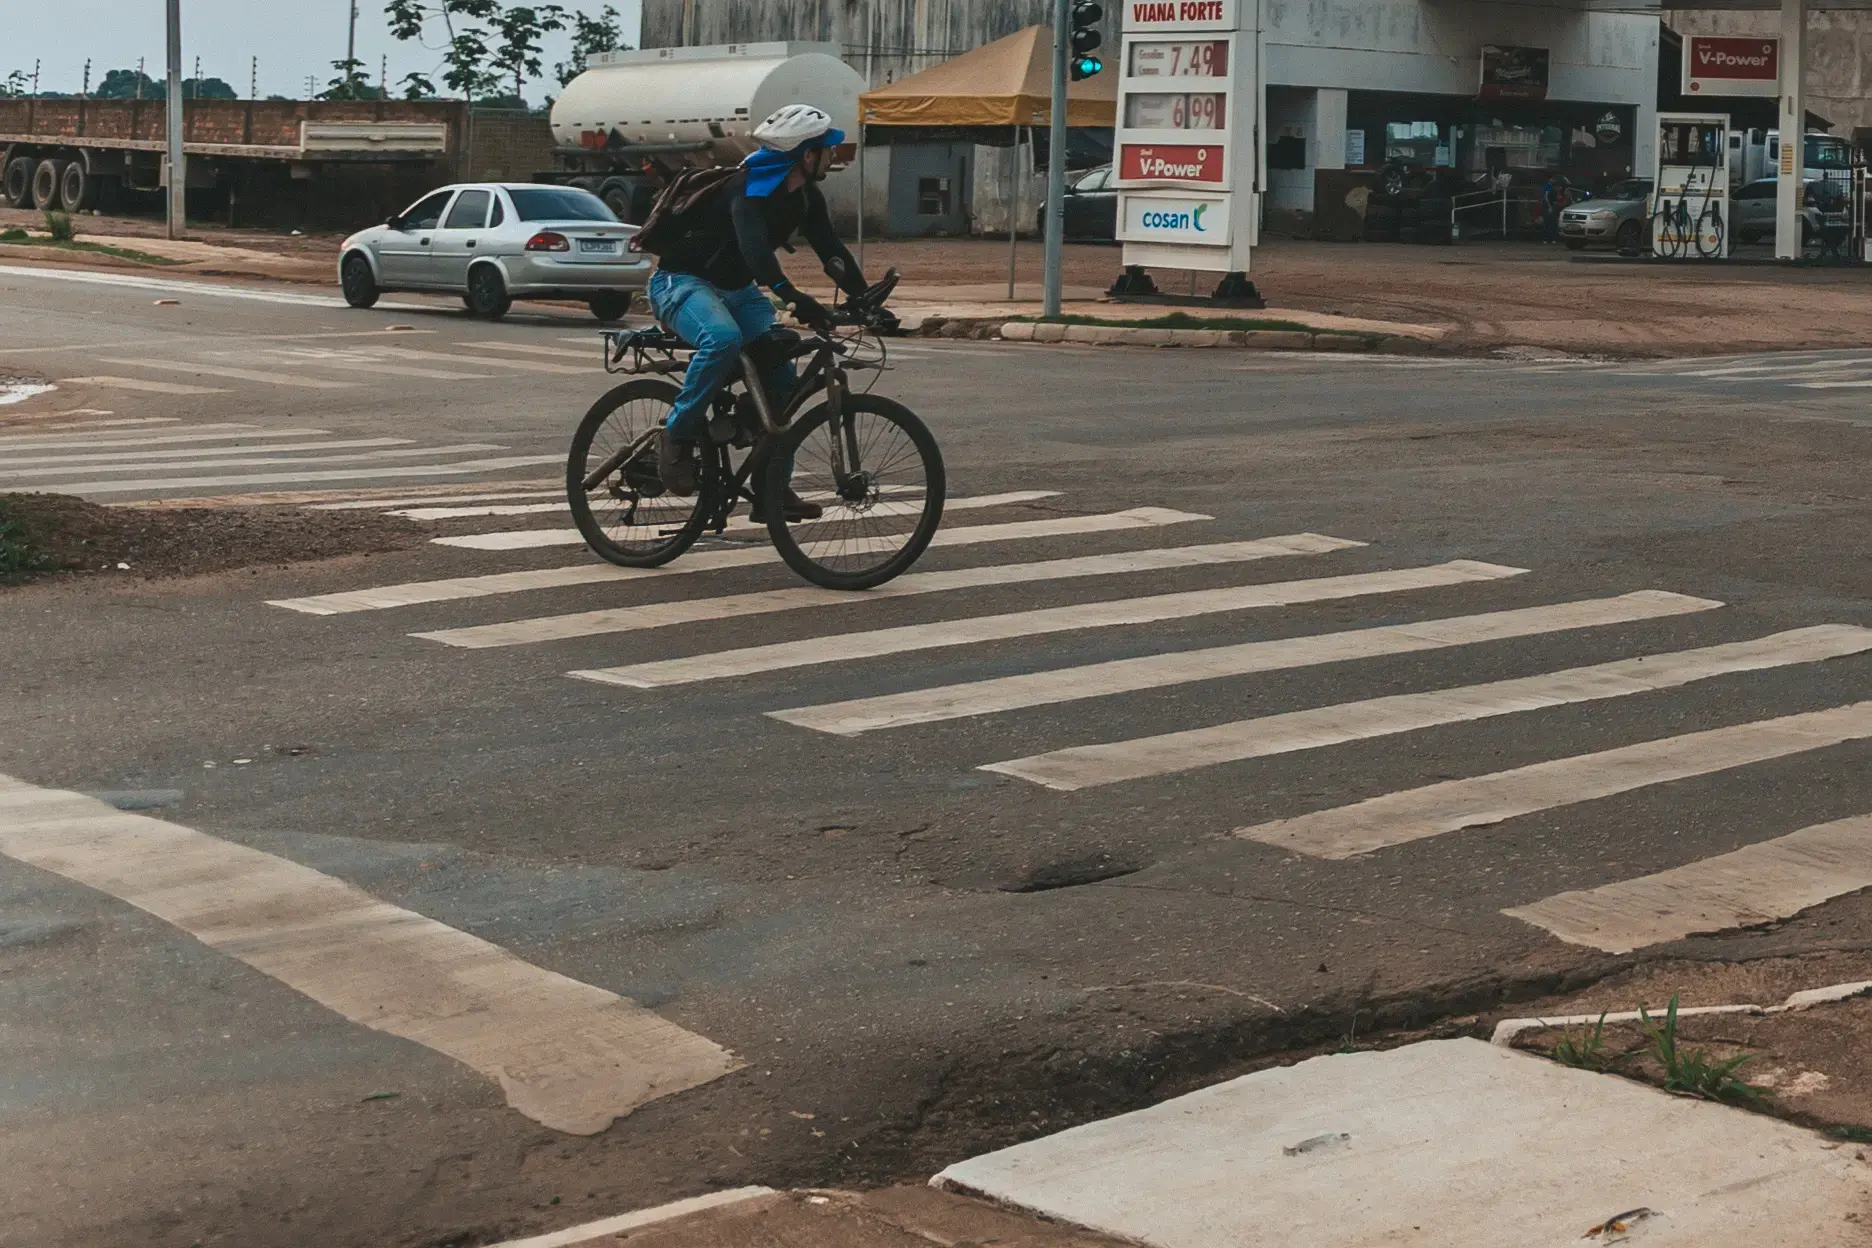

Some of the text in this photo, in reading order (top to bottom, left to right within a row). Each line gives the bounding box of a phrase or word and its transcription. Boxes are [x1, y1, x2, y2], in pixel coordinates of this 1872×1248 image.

[1133, 0, 1223, 23] VIANA FORTE
[1699, 51, 1768, 66] V-Power
[1139, 158, 1203, 177] V-Power
[1142, 211, 1189, 230] cosan
